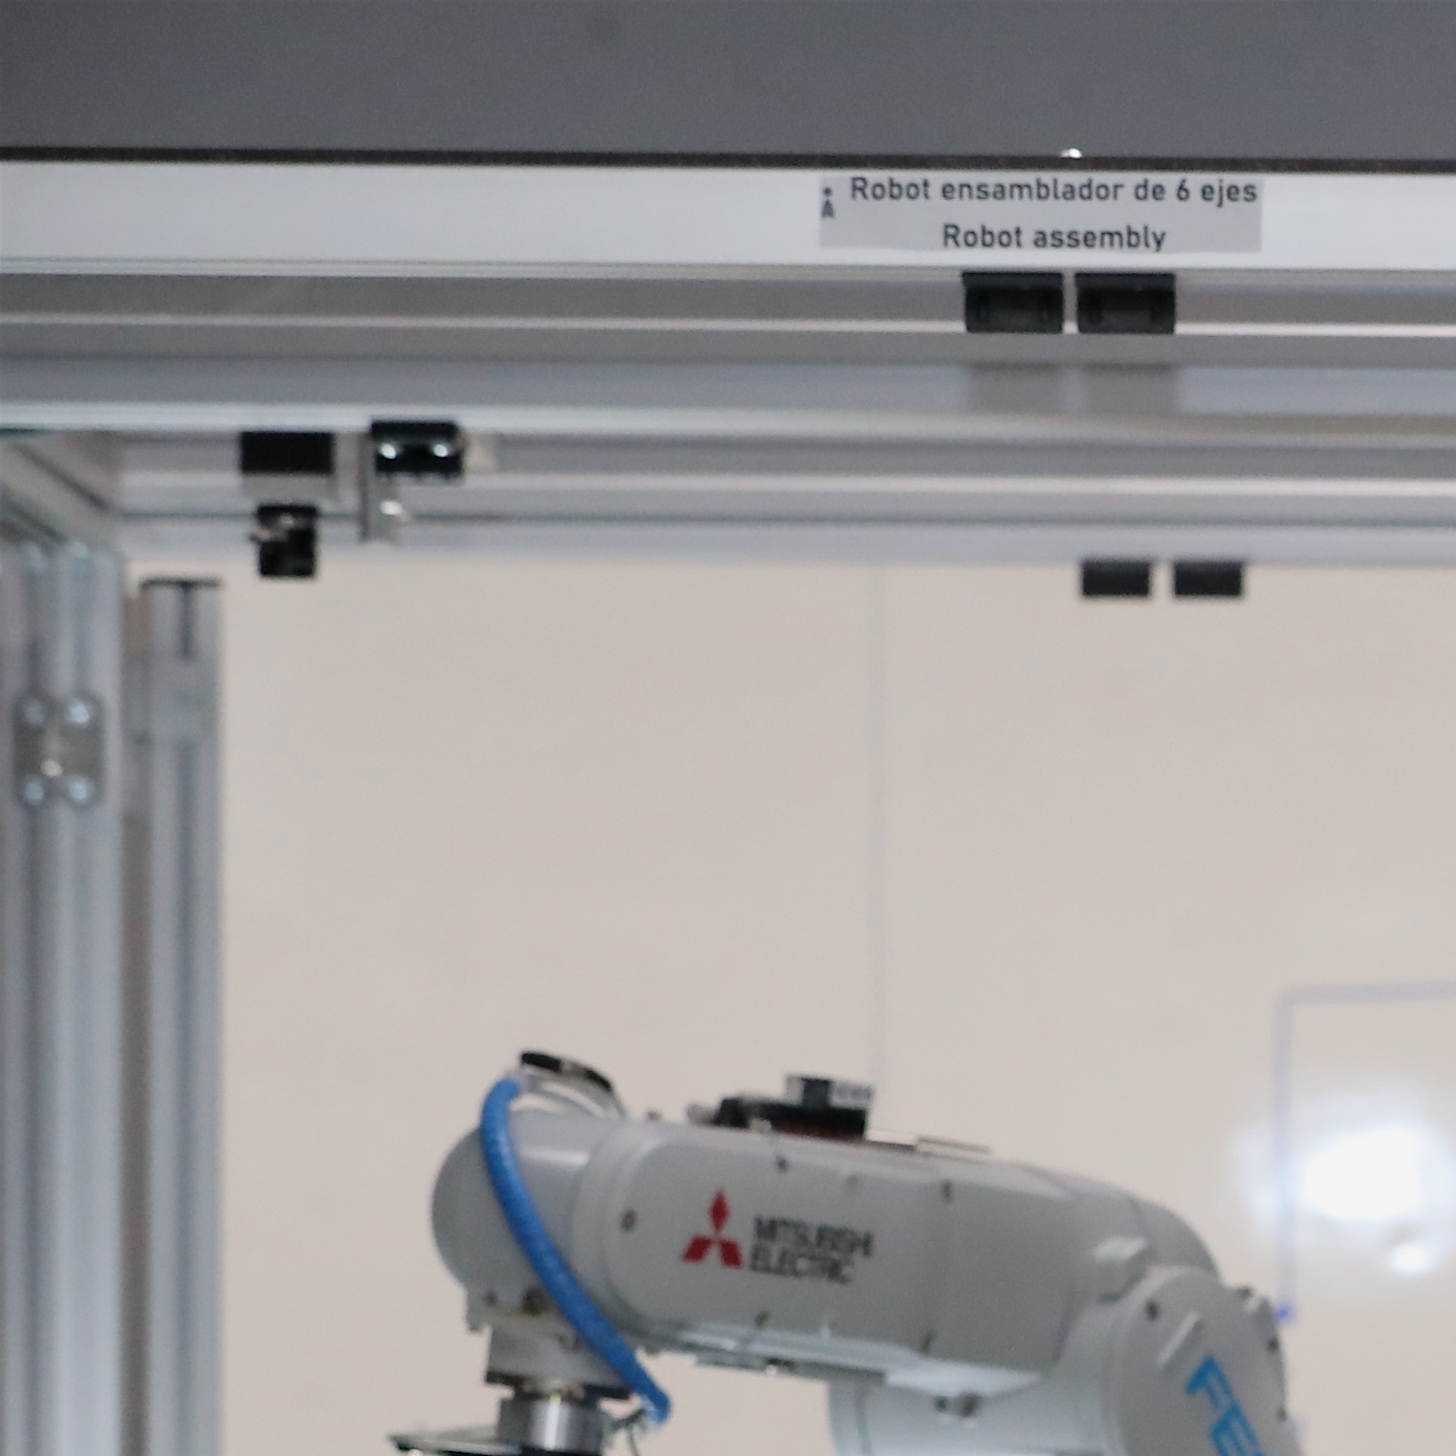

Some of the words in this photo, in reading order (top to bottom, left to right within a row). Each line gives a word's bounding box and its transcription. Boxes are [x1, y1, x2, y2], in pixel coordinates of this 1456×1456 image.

[850, 176, 931, 201] Robot
[941, 176, 1125, 202] ensamblador
[1133, 178, 1166, 202] de
[1175, 178, 1191, 202] 6
[1200, 179, 1258, 207] ejes
[942, 223, 1023, 249] Robot
[1032, 223, 1167, 252] assembly
[752, 1214, 875, 1258] MITSUBISHI
[748, 1240, 855, 1285] ELECTRIC
